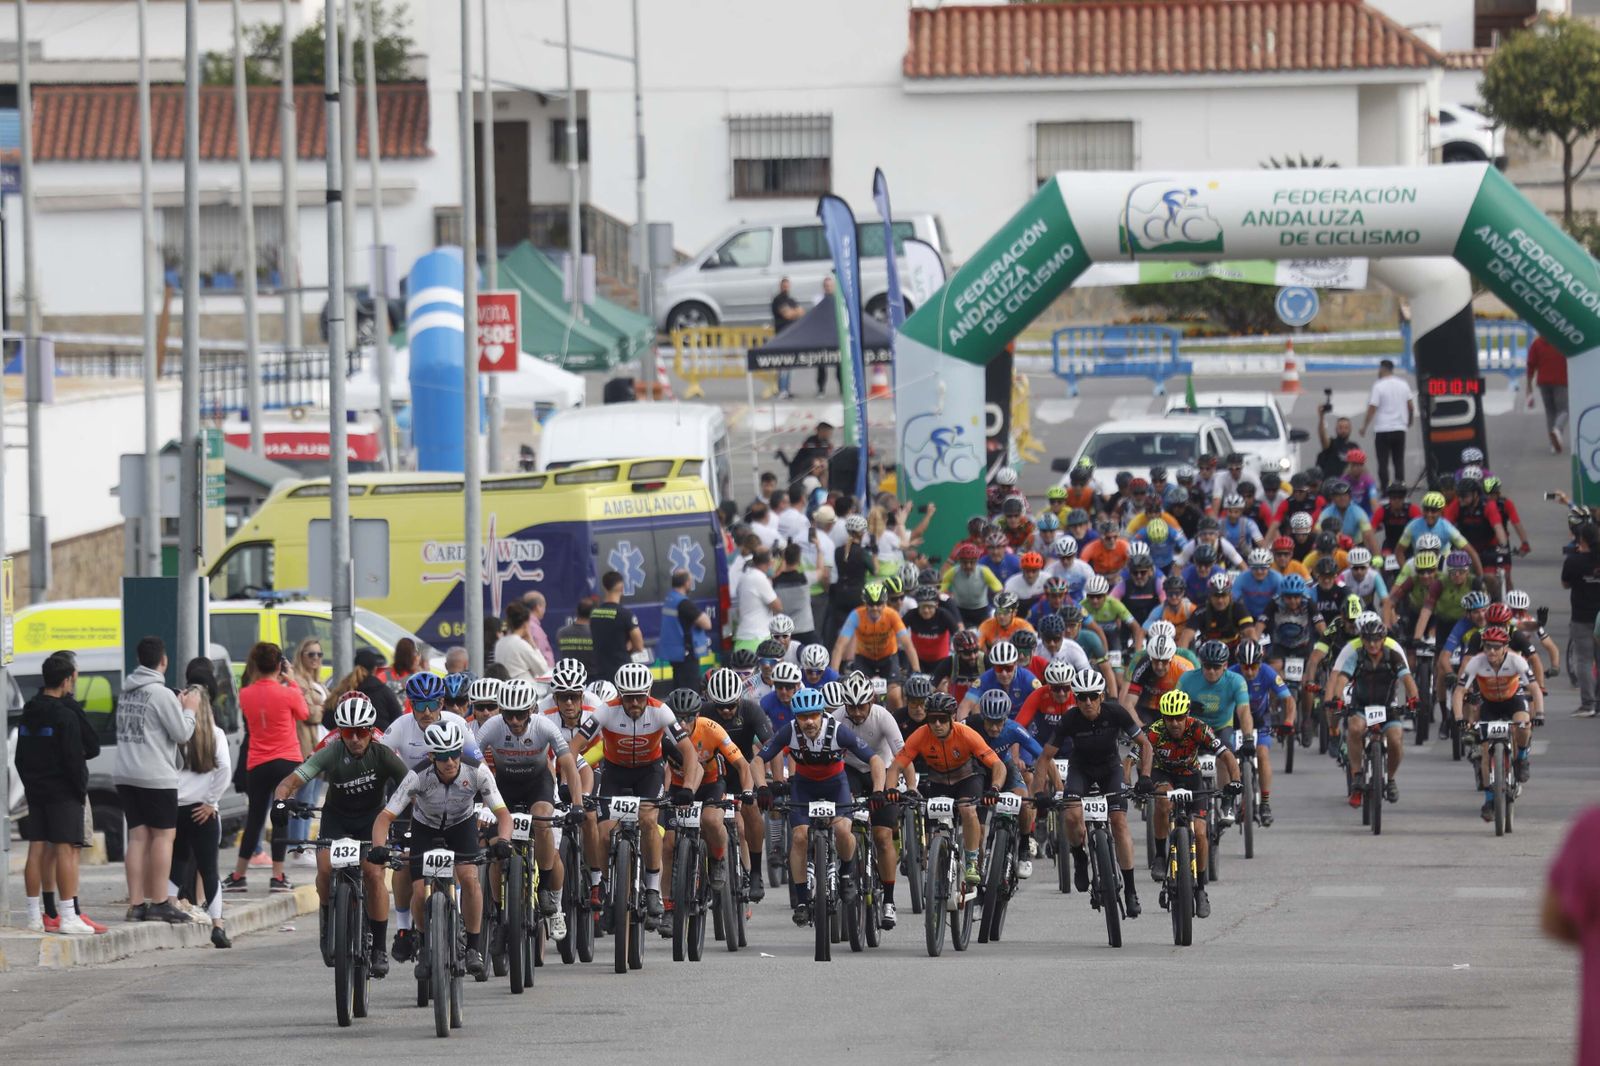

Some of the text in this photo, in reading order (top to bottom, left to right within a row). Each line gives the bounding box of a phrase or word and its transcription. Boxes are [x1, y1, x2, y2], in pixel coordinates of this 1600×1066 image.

[1272, 186, 1417, 204] FEDERACIÓN
[1241, 209, 1365, 227] ANDALUZA
[1279, 229, 1421, 246] DE CICLISMO
[953, 218, 1049, 314] FEDERACIÓN
[1473, 224, 1561, 303] ANDALUZA
[982, 243, 1075, 335] DE CICLISMO
[948, 263, 1030, 346] ANDALUZA
[1486, 257, 1585, 345] DE CICLISMO
[603, 495, 697, 515] AMBULANCIA
[333, 773, 377, 789] TREK
[345, 783, 375, 795] JEREZ
[613, 800, 637, 814] 452
[1084, 802, 1106, 813] 493
[512, 817, 529, 832] 89
[332, 846, 357, 858] 432
[425, 854, 452, 868] 402
